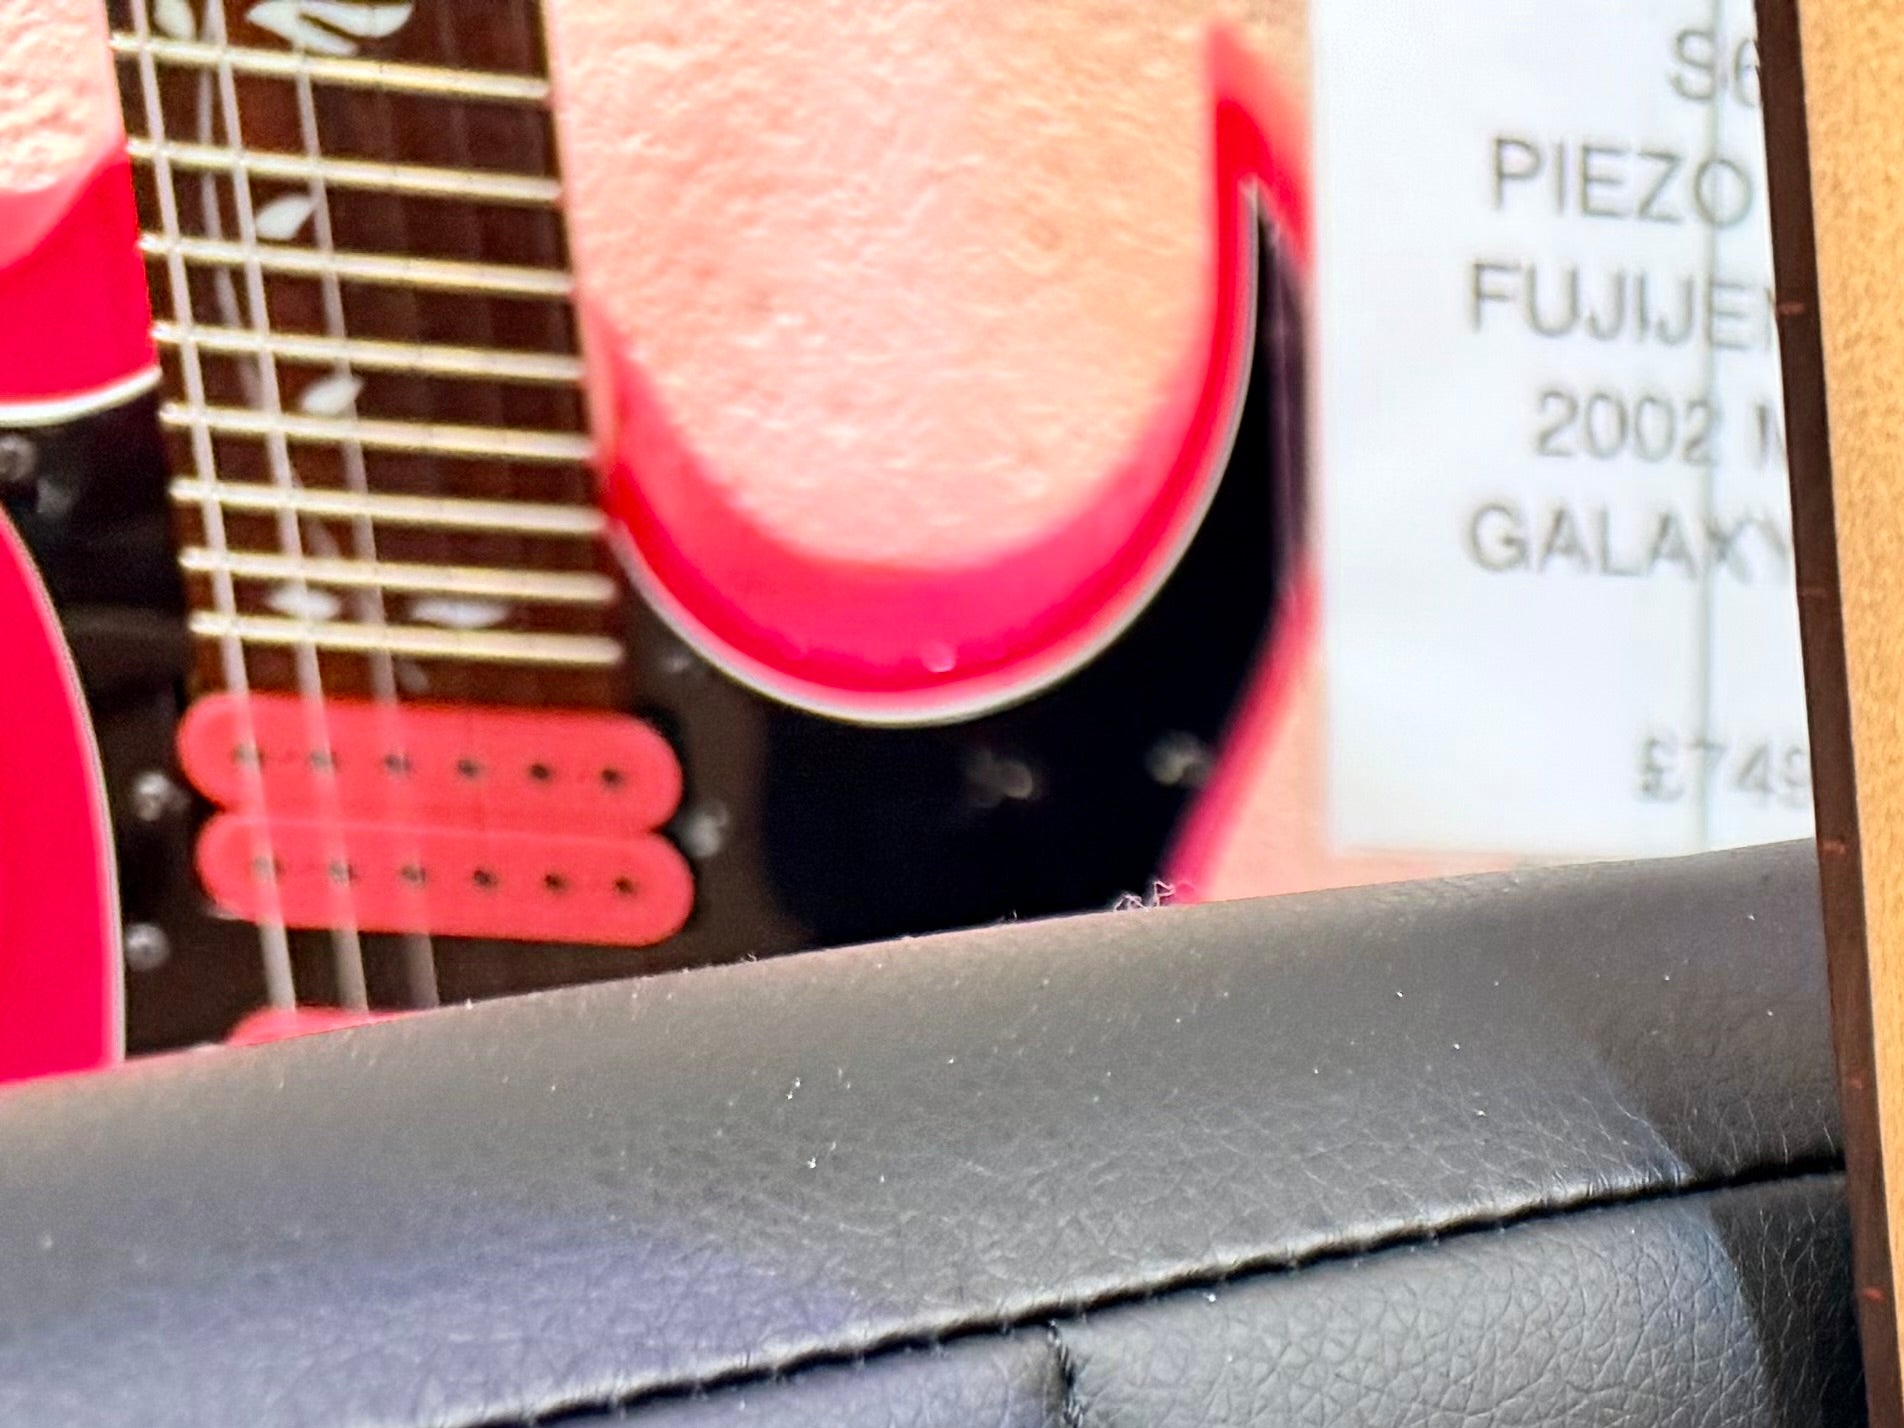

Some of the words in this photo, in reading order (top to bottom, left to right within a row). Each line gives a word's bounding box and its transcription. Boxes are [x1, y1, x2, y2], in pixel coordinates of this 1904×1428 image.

[1490, 136, 1755, 230] PIEZO
[1471, 261, 1773, 353] FUJIJE
[1535, 388, 1716, 467] 2002
